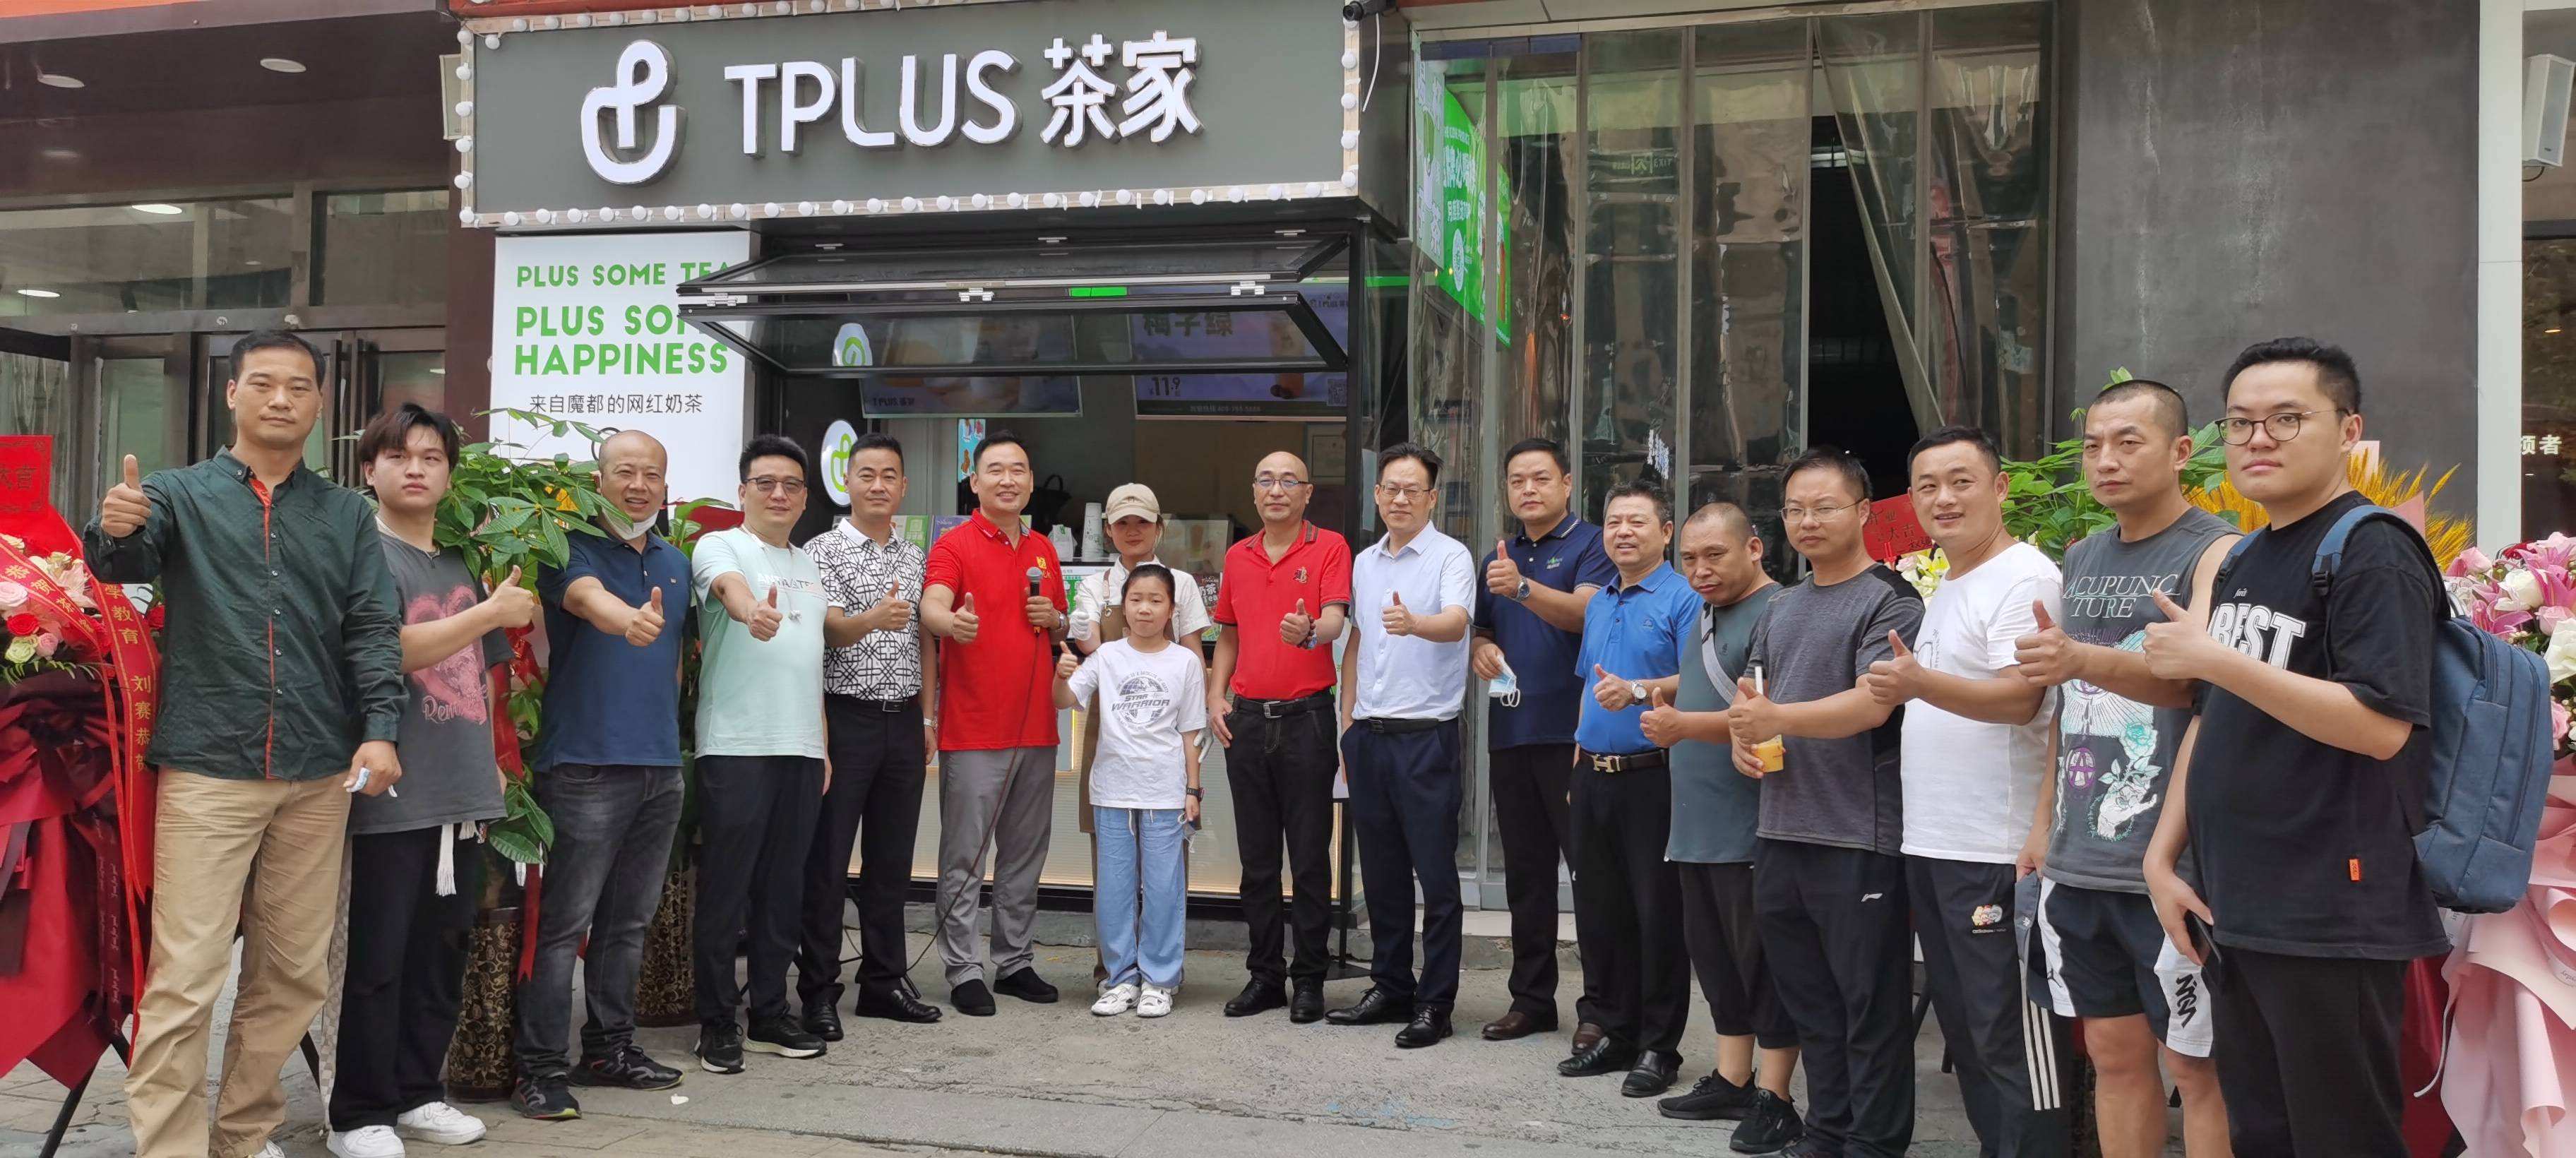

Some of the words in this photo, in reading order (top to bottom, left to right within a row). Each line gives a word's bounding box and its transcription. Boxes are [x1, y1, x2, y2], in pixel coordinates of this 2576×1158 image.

[724, 49, 1021, 156] TPLUS
[1039, 30, 1203, 148] 茶家
[1653, 158, 1673, 168] EXIT
[517, 265, 579, 287] PLUS
[592, 263, 666, 286] SOME
[680, 262, 729, 282] TE
[516, 306, 604, 337] PLUS
[515, 342, 728, 375] HAPPINESS
[530, 394, 703, 414] 来自魔都的网红奶茶
[2062, 573, 2178, 599] ACUPUNC
[2070, 597, 2137, 619] TURE
[1111, 699, 1170, 712] WARRIOR
[1124, 693, 1149, 702] STAR
